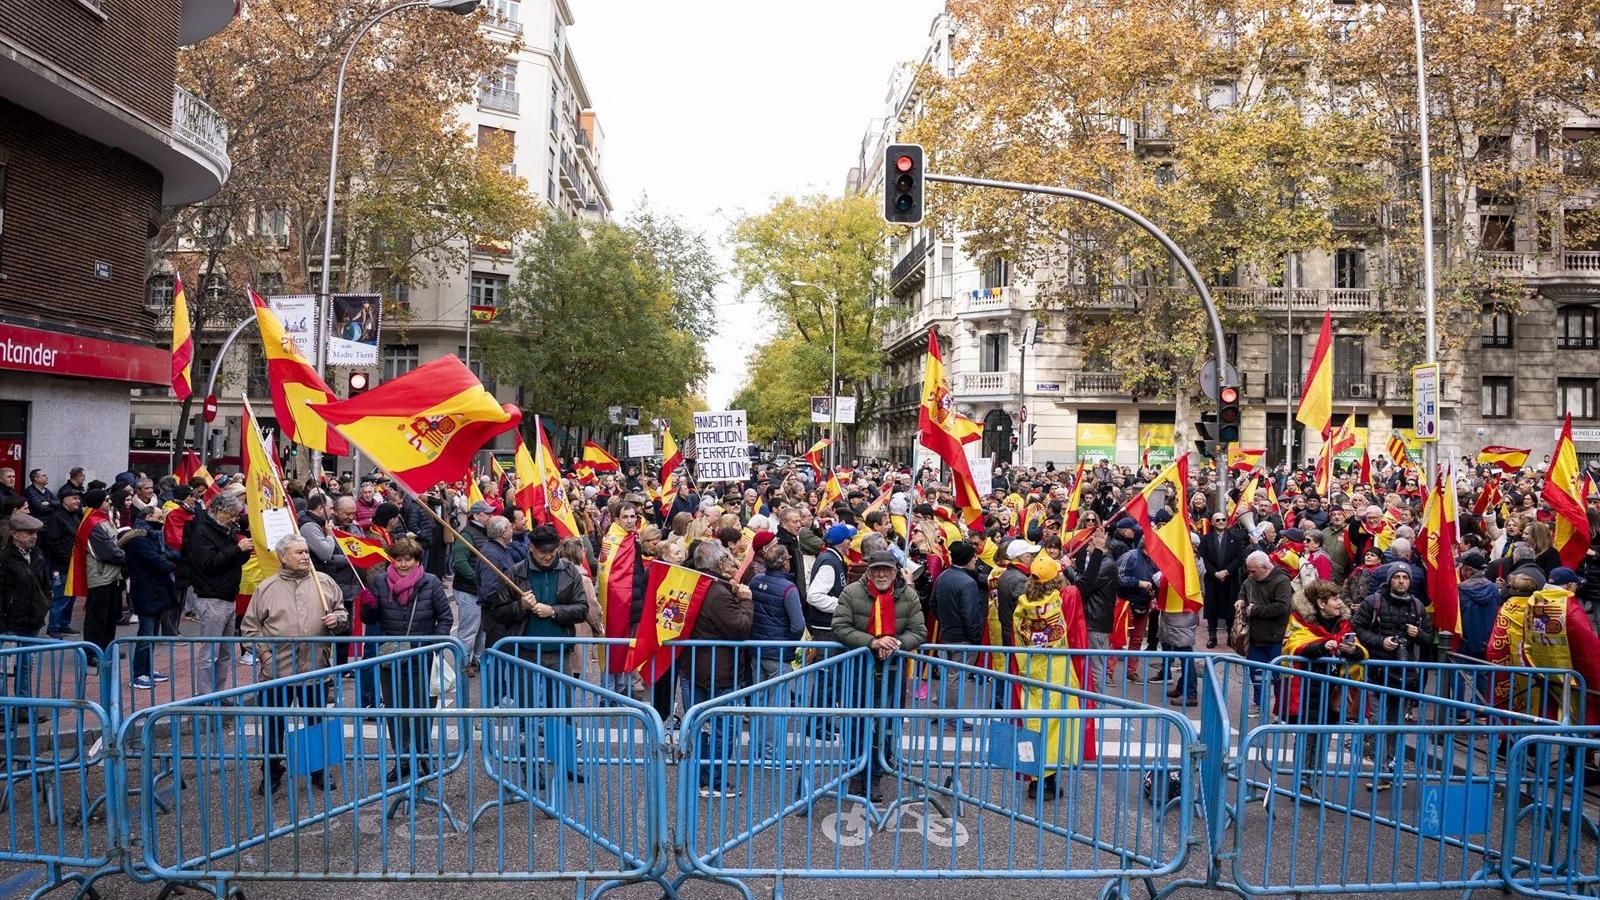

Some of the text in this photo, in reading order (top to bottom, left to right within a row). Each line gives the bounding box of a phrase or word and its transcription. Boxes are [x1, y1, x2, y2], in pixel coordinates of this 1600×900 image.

[332, 351, 353, 359] Madre
[696, 430, 743, 444] TRAICION
[697, 445, 736, 459] FERRAZ
